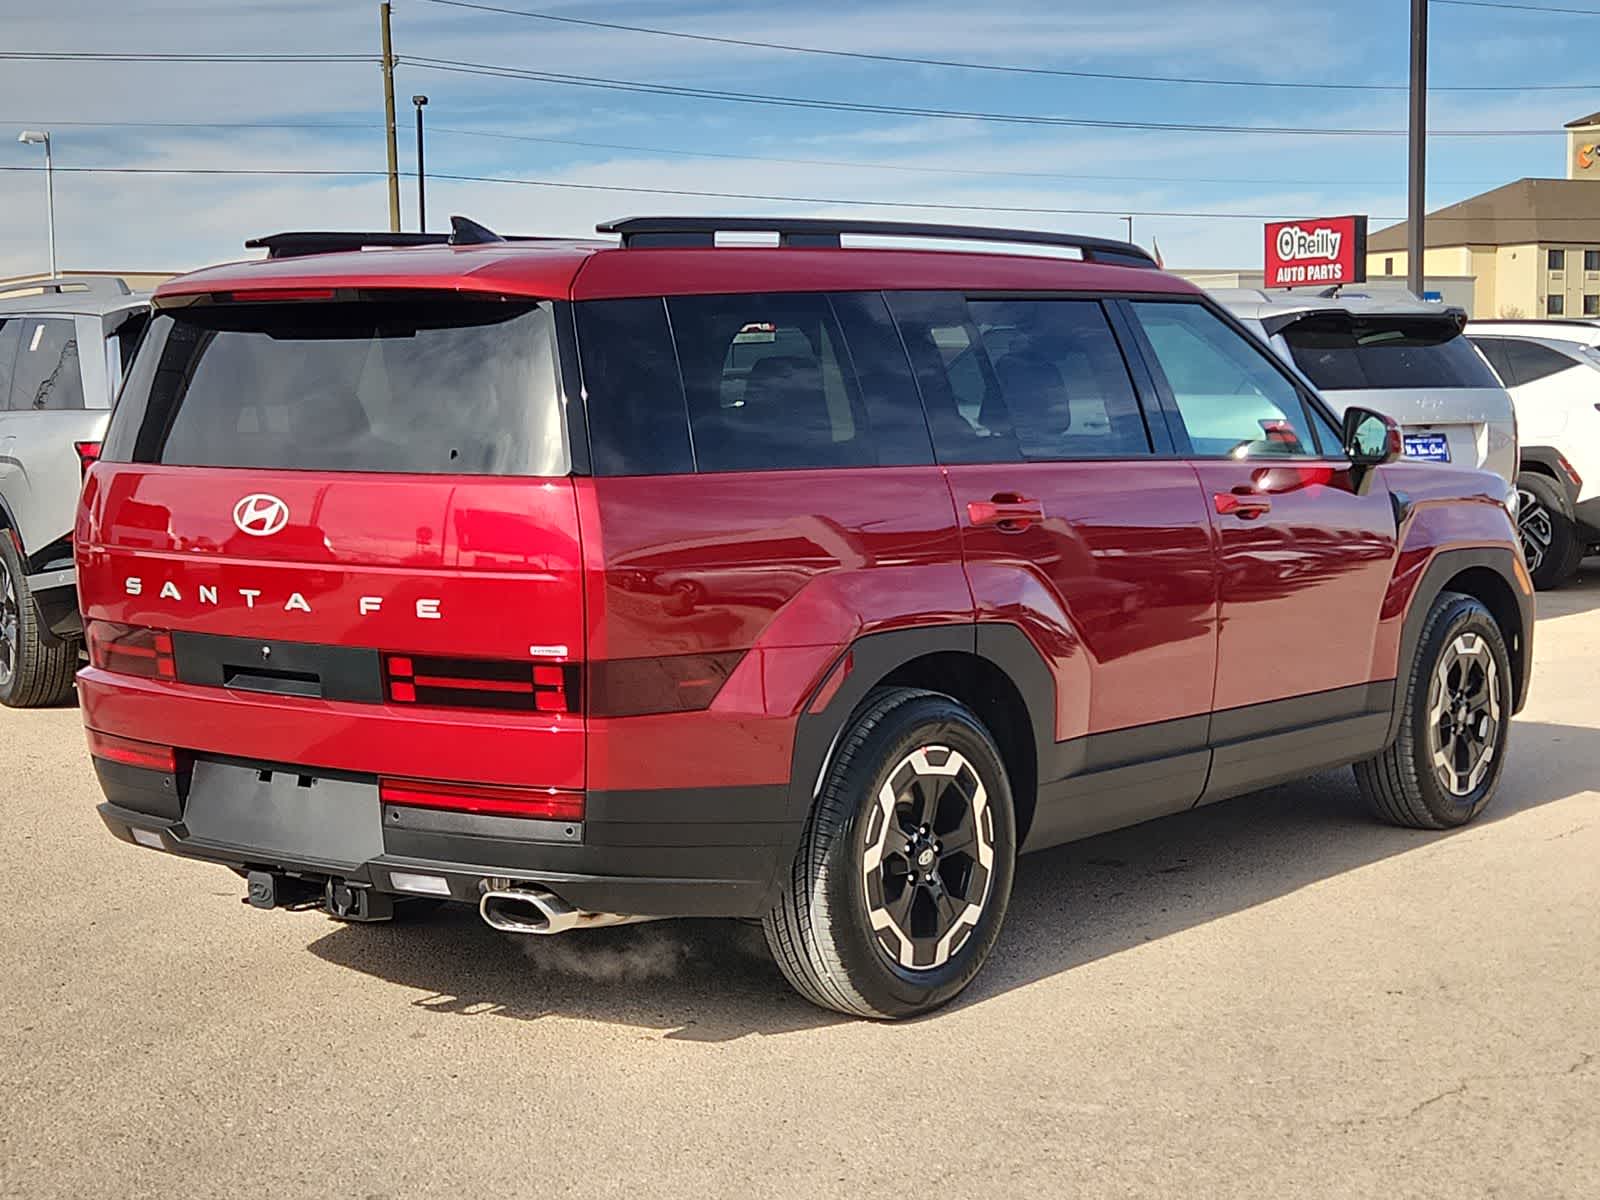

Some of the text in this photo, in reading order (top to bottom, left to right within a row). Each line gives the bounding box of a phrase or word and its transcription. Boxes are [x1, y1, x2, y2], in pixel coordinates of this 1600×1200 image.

[1278, 228, 1340, 259] O'Reilly
[1276, 263, 1342, 283] AUTO PARTS
[125, 577, 442, 620] SANTA FE
